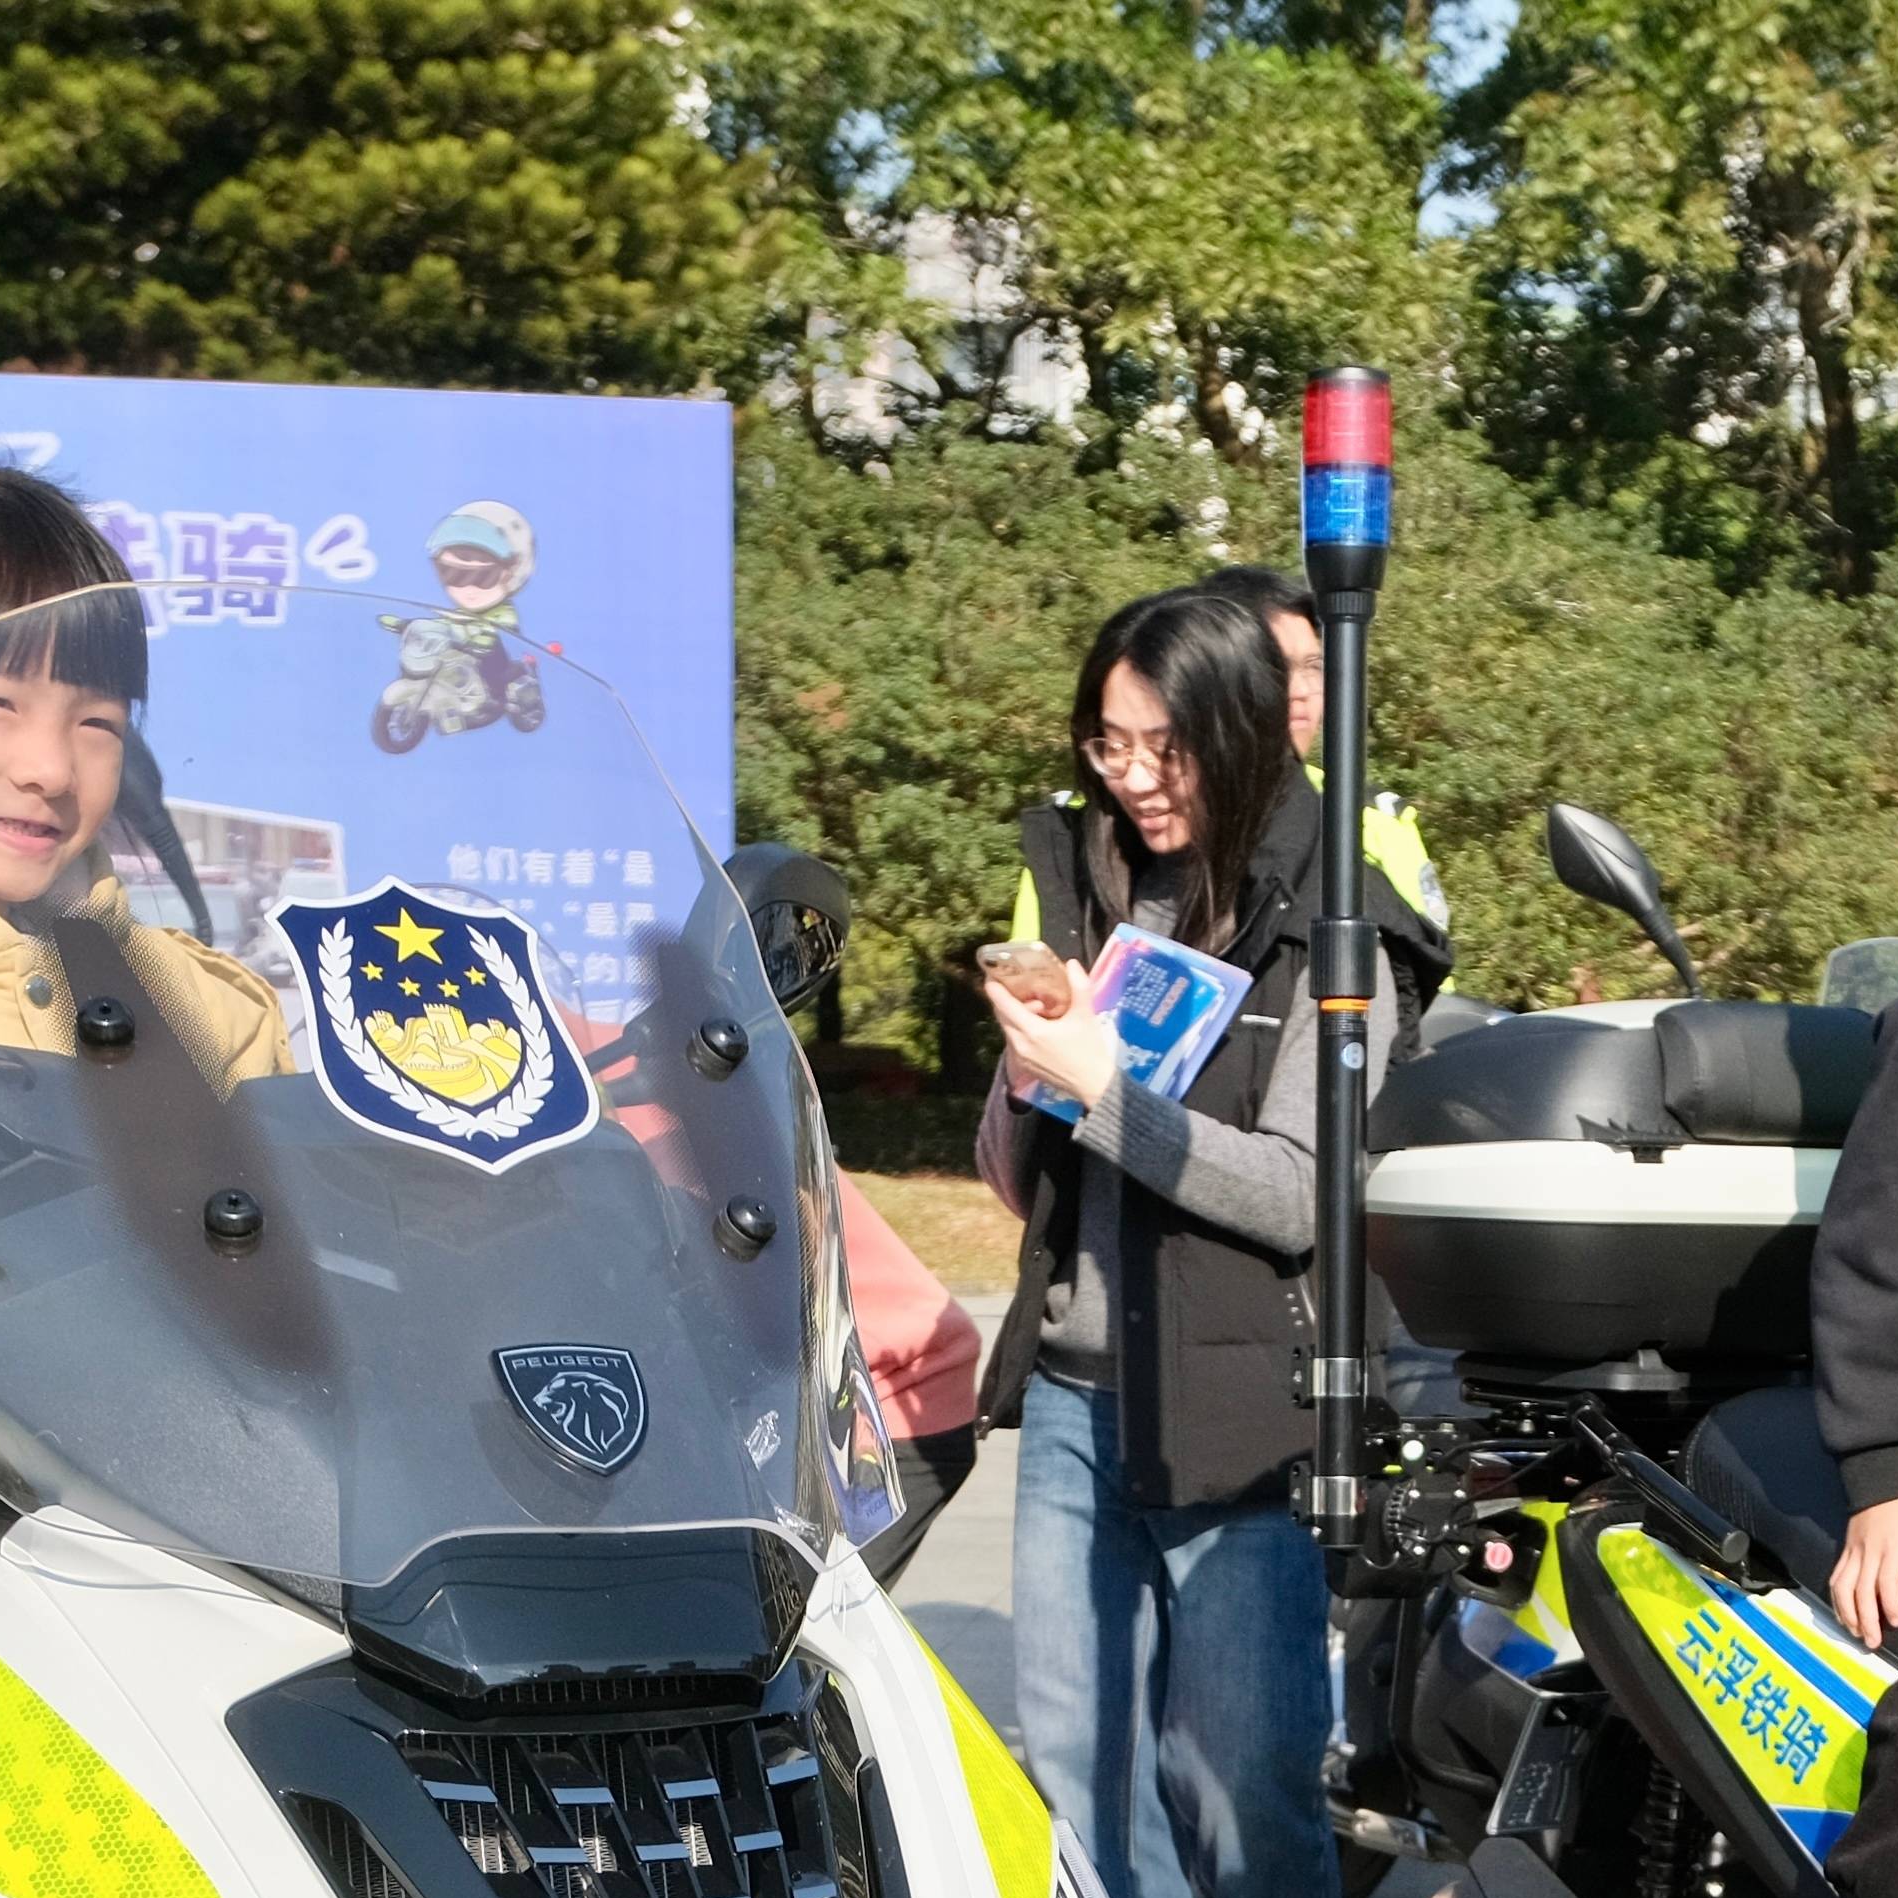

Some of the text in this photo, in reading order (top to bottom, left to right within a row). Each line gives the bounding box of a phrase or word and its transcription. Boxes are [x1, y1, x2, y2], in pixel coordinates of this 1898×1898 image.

[511, 1355, 622, 1370] PEUGEOT
[1676, 1608, 1829, 1785] 云浮铁骑
